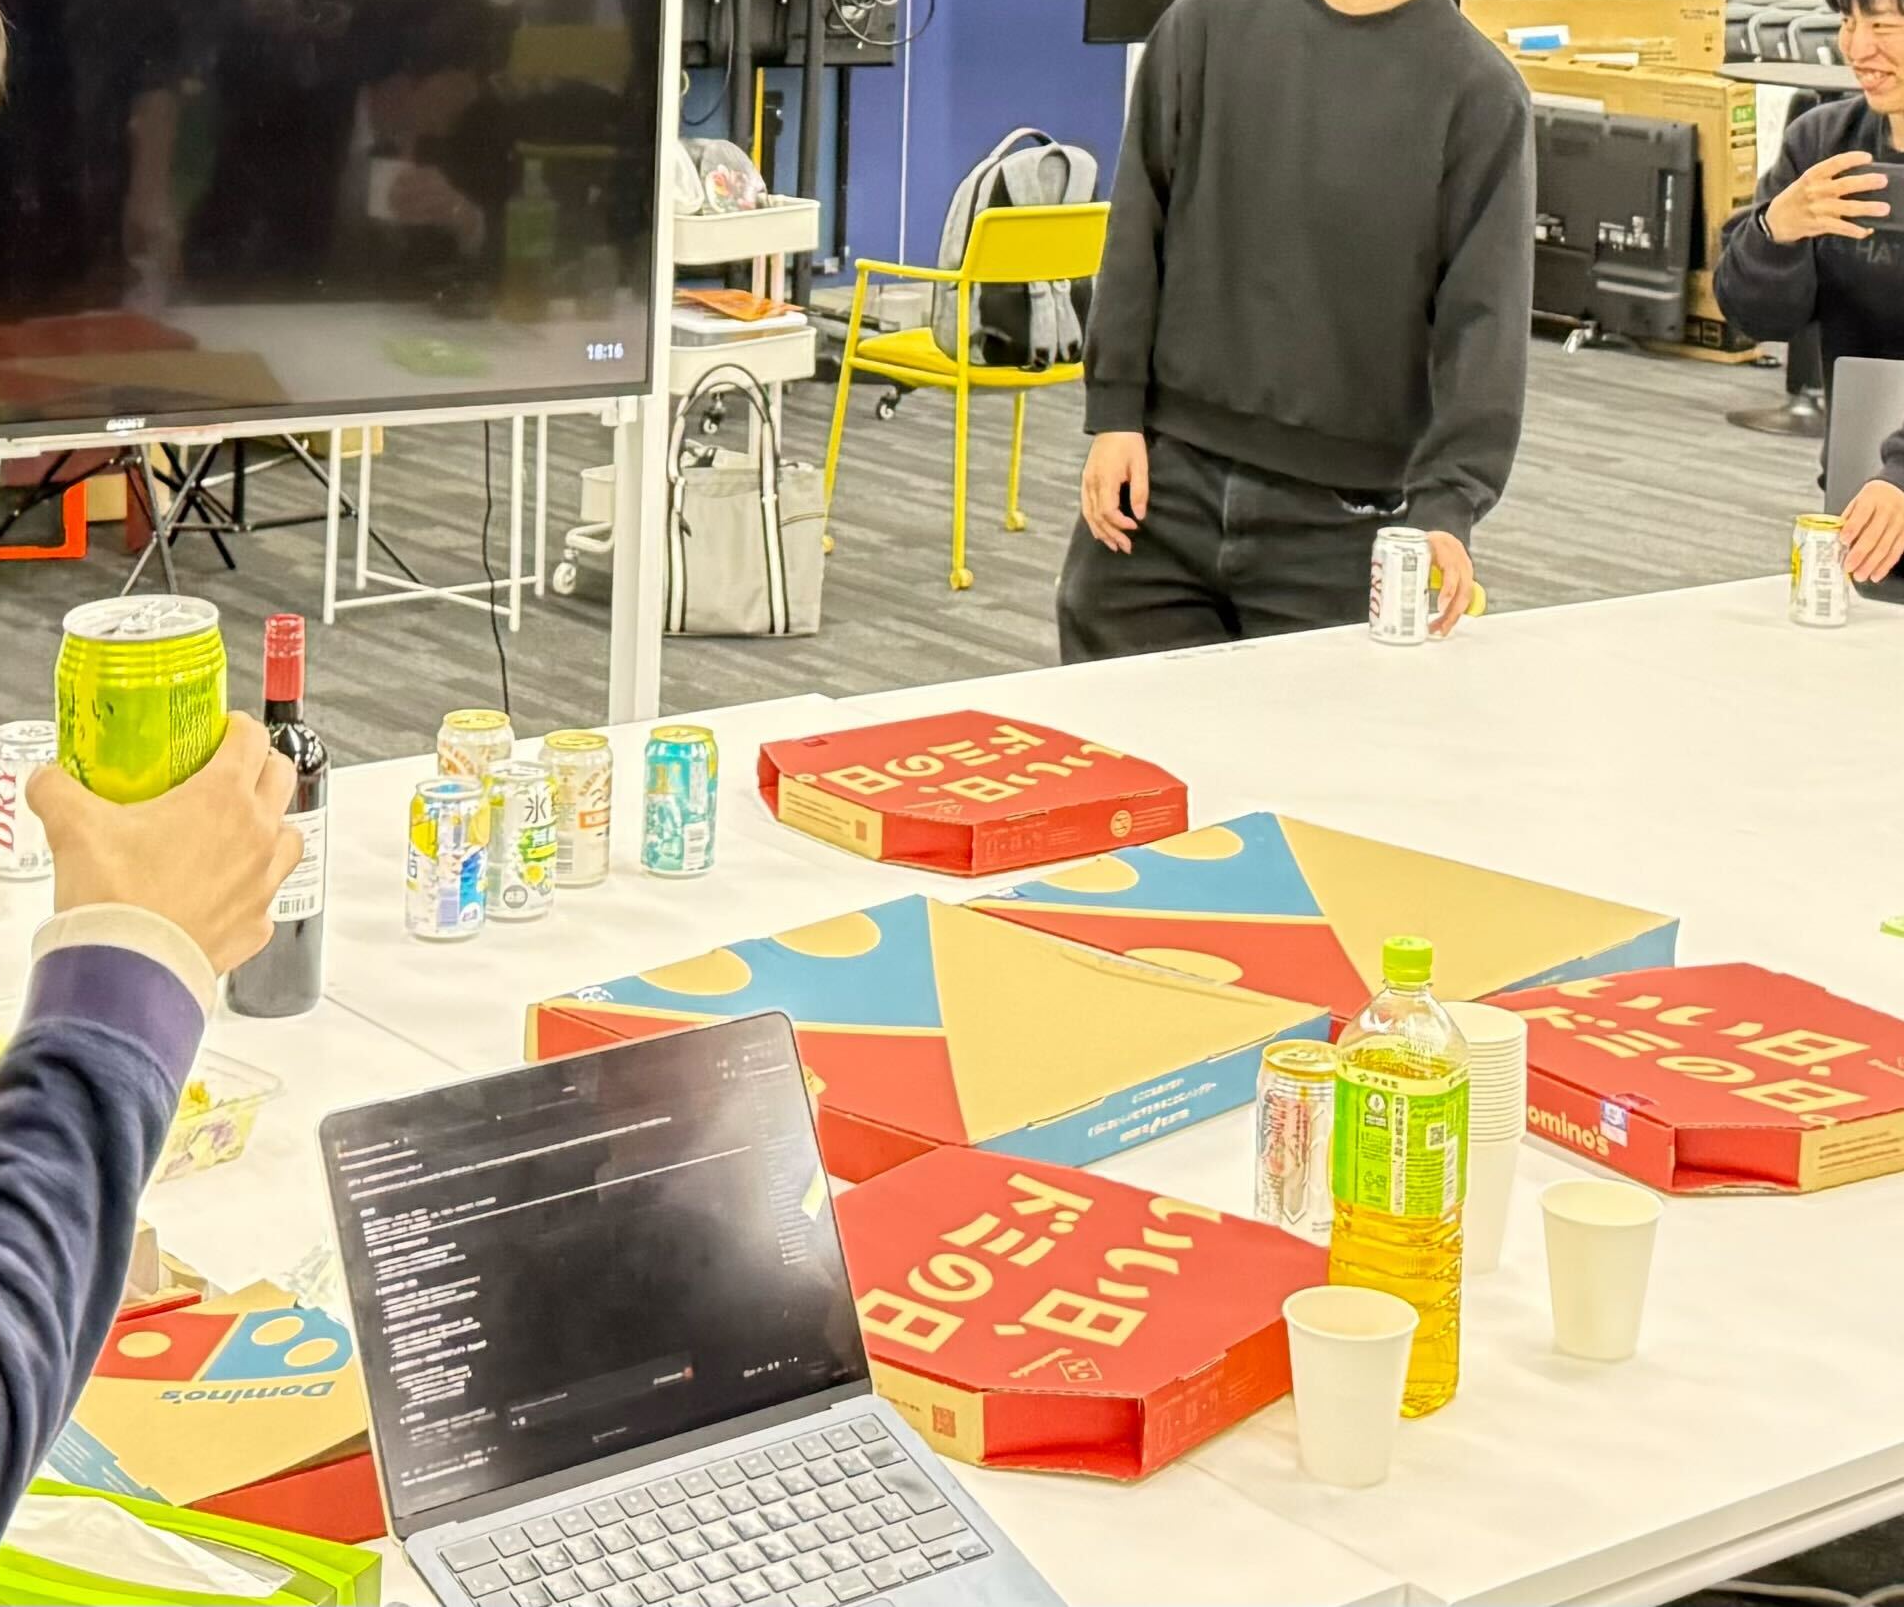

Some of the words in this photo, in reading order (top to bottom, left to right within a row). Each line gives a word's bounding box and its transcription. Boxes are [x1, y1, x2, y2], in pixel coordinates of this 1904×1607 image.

[794, 725, 1047, 796] ドミの日。
[1556, 978, 1872, 1077] いい日、
[1527, 1106, 1610, 1157] omino's
[858, 1172, 1095, 1354] ドミの日
[162, 1381, 335, 1404] Domino's
